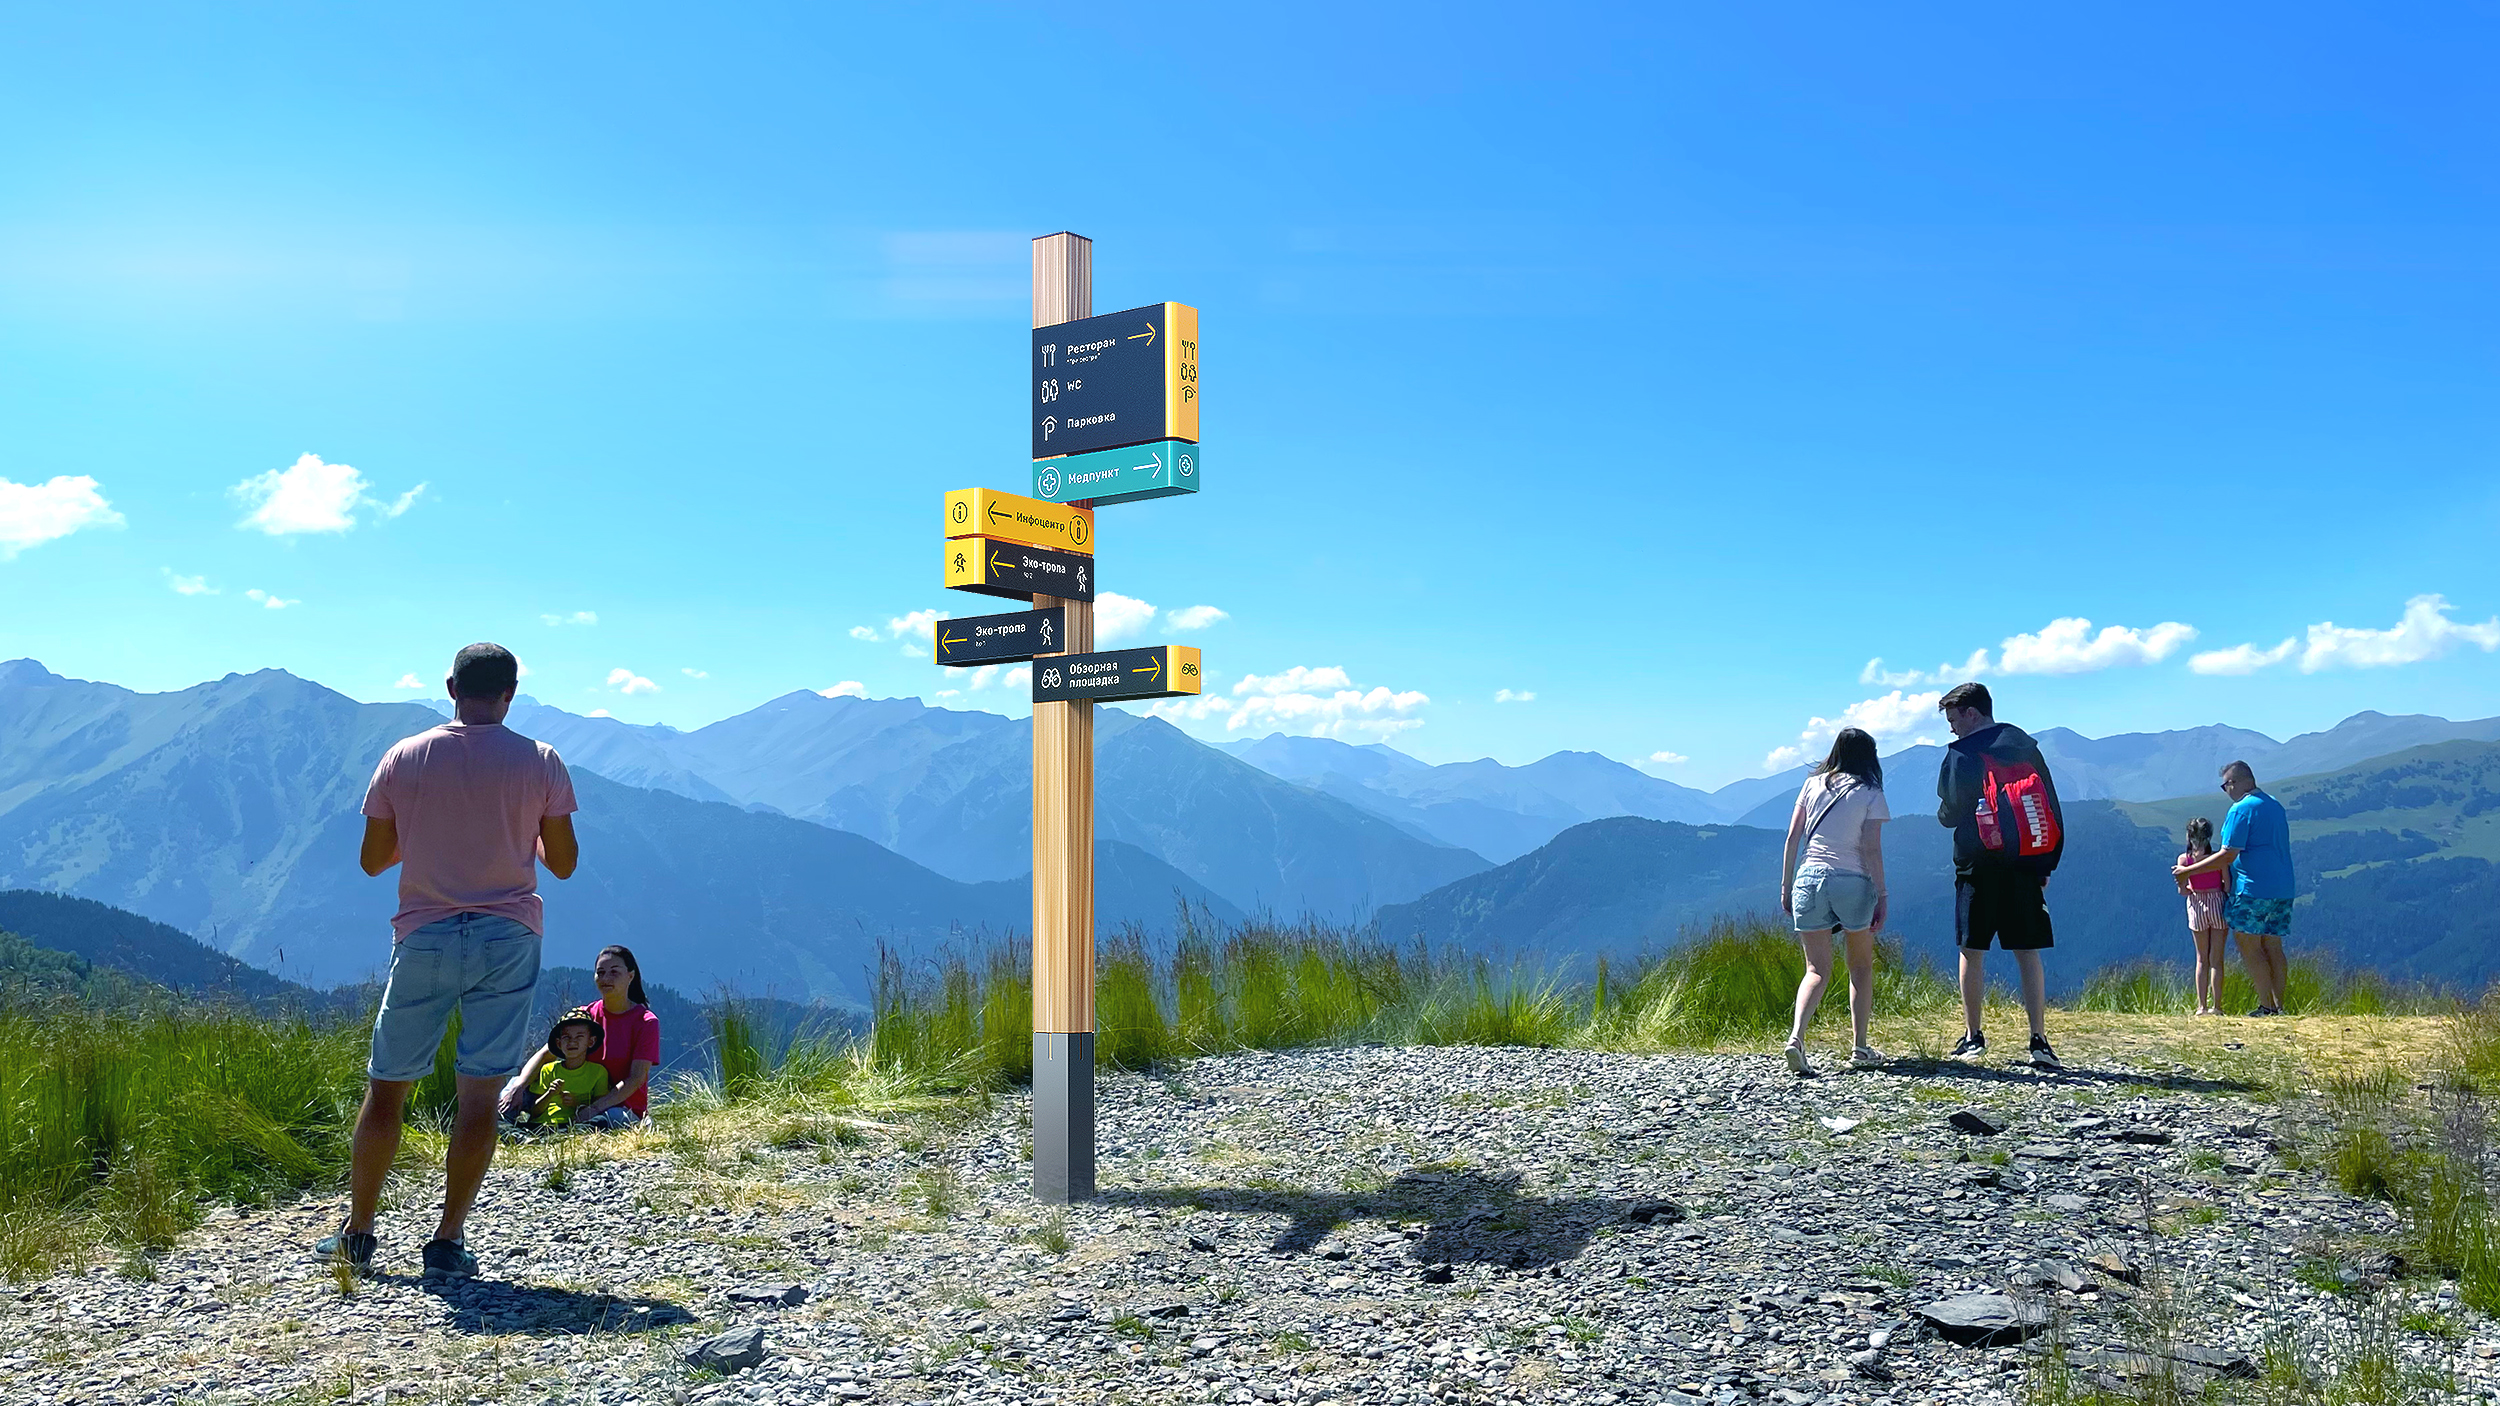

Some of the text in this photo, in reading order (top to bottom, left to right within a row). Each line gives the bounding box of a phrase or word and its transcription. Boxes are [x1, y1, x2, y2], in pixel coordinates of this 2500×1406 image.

[1067, 338, 1116, 356] Ресторан
[1066, 379, 1083, 392] WC
[1066, 412, 1116, 429] Парковка
[1068, 467, 1120, 485] Медпункт
[1016, 511, 1065, 533] Инфоцентр
[1022, 555, 1066, 574] Эко-тропа
[975, 623, 1026, 637] Эко-тропа
[1069, 661, 1118, 676] Обзорная
[1069, 673, 1120, 689] площадка
